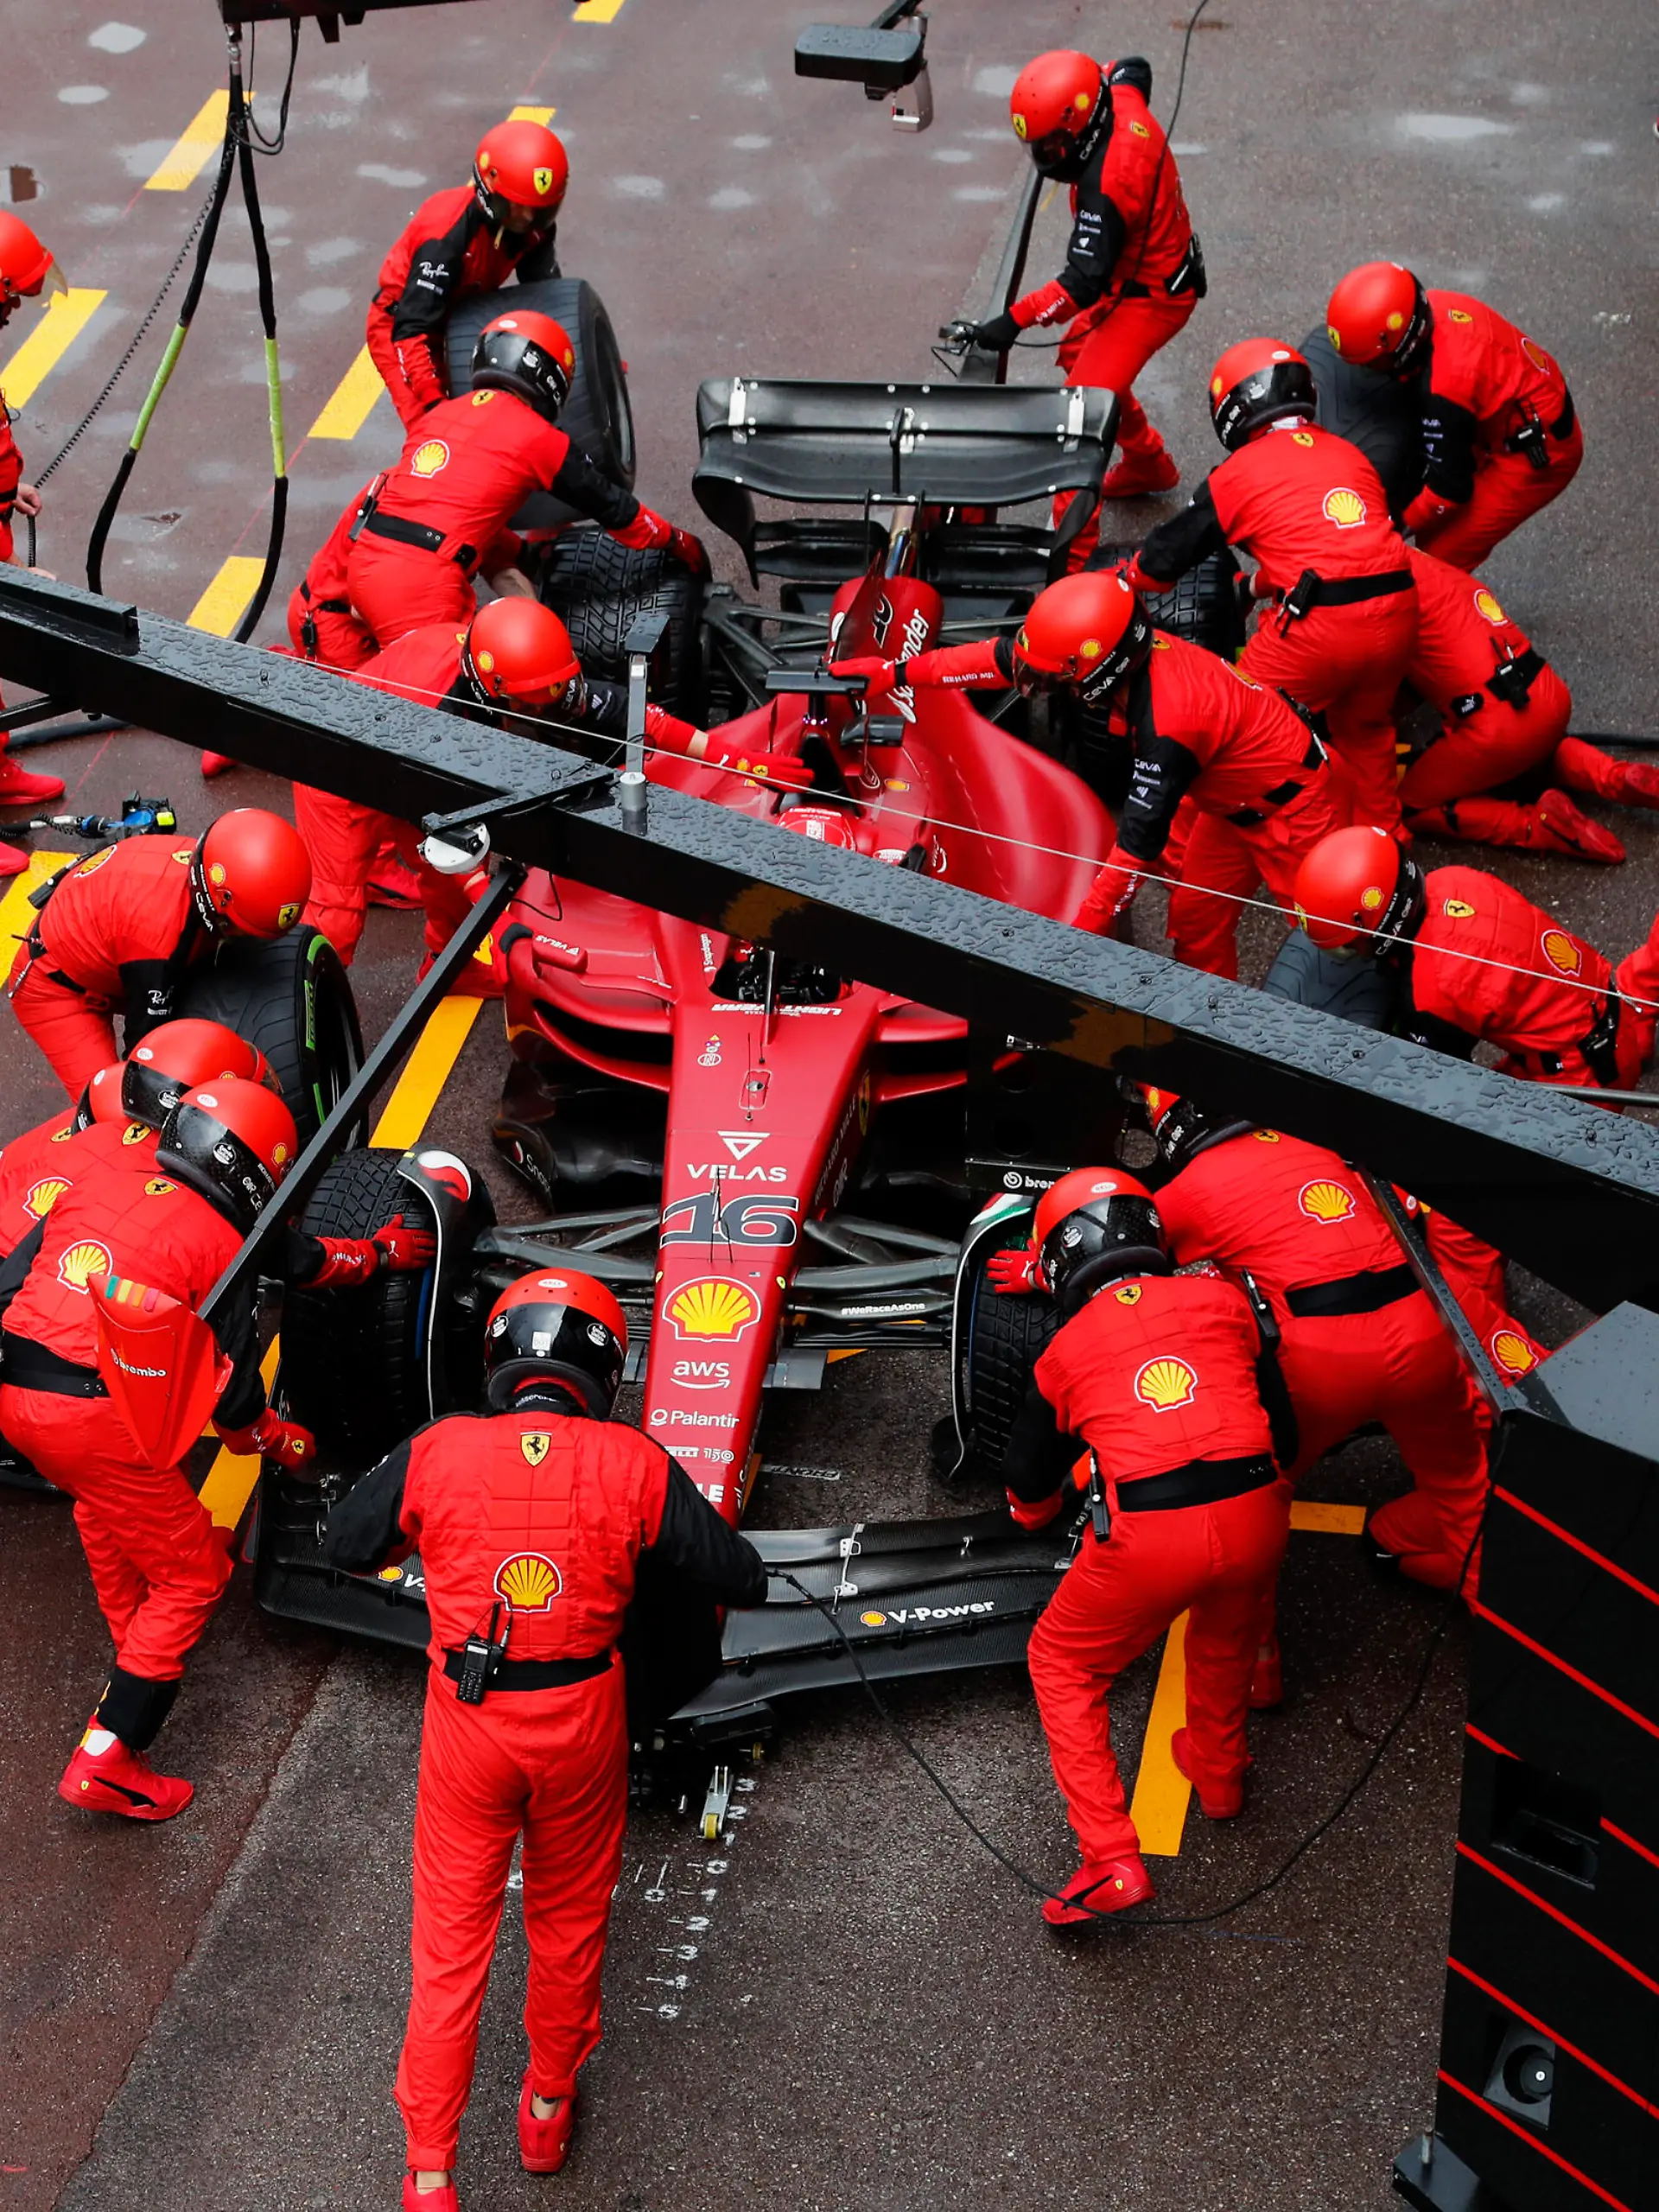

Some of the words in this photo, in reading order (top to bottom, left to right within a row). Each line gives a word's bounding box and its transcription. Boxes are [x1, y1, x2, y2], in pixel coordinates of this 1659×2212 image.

[1084, 676, 1116, 701] CEVA
[195, 891, 214, 932] CEVA
[687, 1164, 787, 1183] VELAS
[250, 1193, 264, 1211] CE
[660, 1192, 799, 1249] 16
[842, 1303, 925, 1315] #WeRaceAsOne
[119, 1359, 167, 1378] brembo
[673, 1360, 730, 1378] aws
[671, 1410, 740, 1428] Palantir
[887, 1600, 995, 1624] V-Power
[685, 1916, 710, 1931] 2
